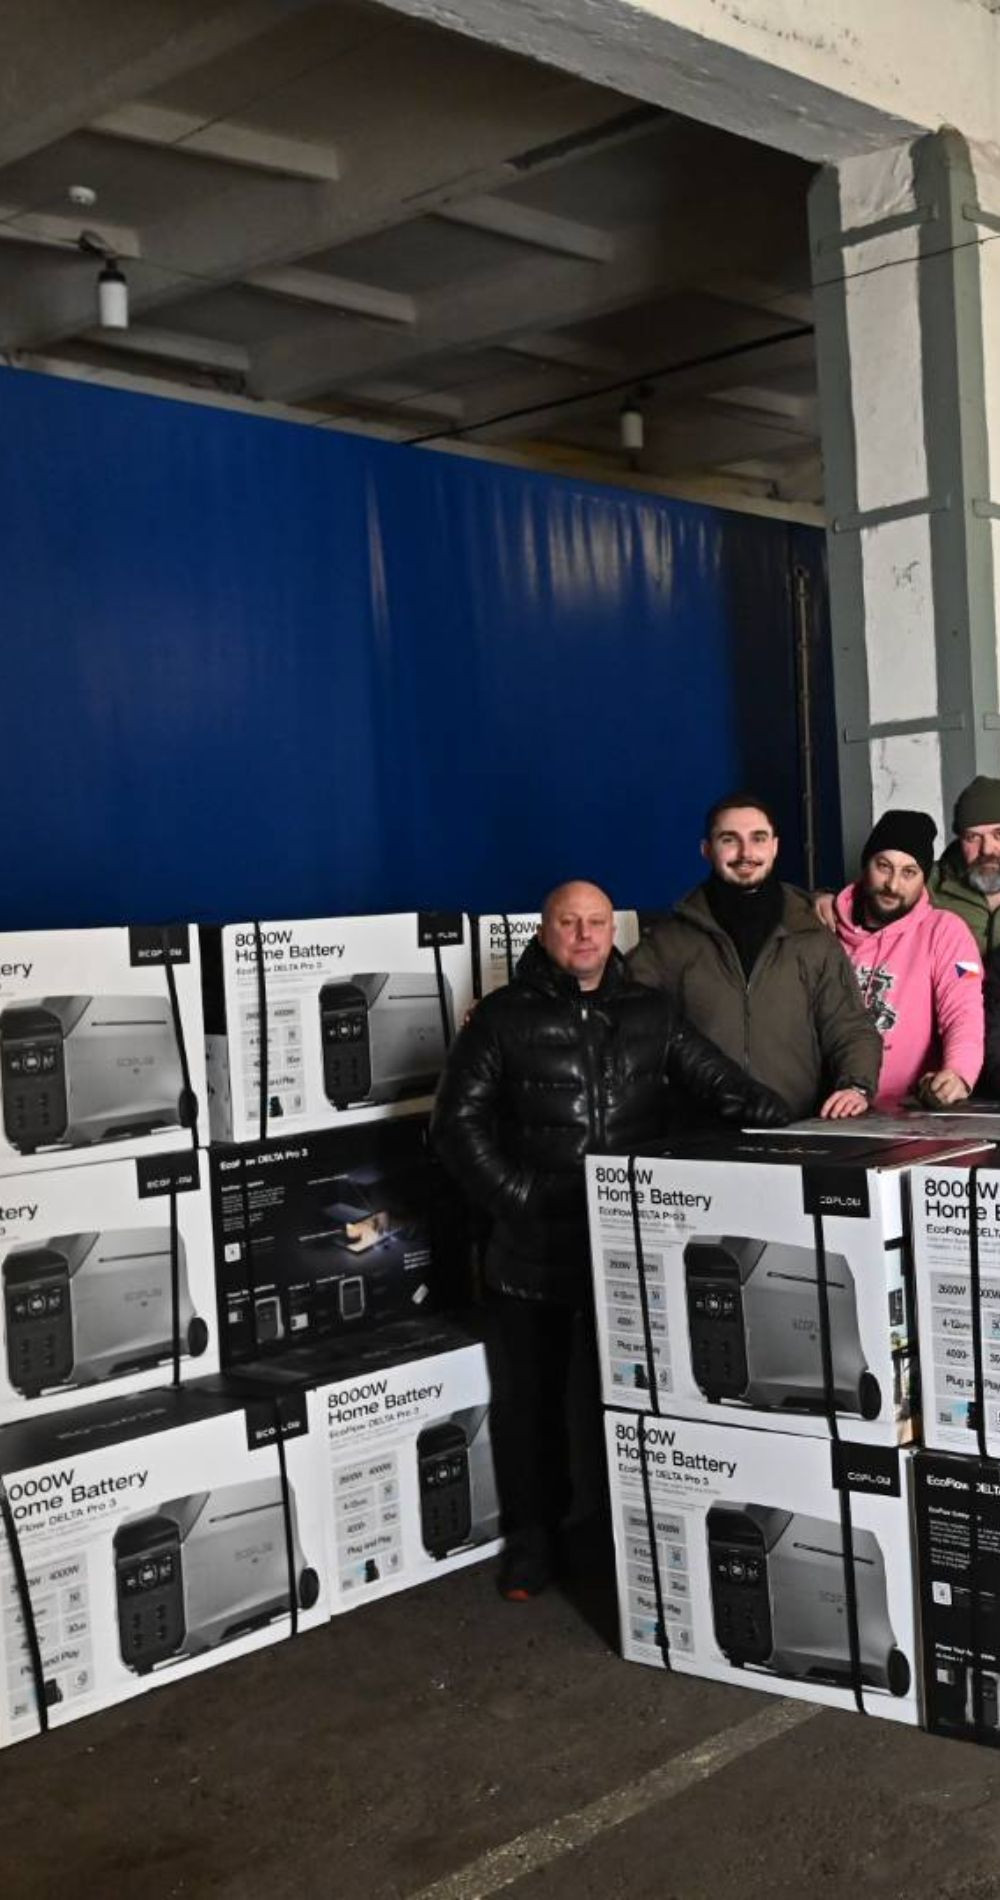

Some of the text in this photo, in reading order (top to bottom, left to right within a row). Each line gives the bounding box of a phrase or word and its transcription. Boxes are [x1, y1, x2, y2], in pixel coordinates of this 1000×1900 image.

[235, 943, 345, 963] Home Battery
[236, 967, 271, 976] EcoFw
[257, 1153, 284, 1164] DELTA
[285, 1150, 300, 1161] Pro
[301, 1147, 309, 1158] 3
[595, 1167, 653, 1185] 800W
[650, 1188, 712, 1212] Battery
[926, 1199, 988, 1220] Home
[926, 1223, 970, 1236] EcoFlow
[327, 1379, 388, 1409] 8000W
[328, 1382, 444, 1426] Home Battery
[329, 1423, 366, 1440] EcoFlow
[368, 1414, 395, 1428] DELTA
[672, 1450, 737, 1479] Battery
[8, 1469, 75, 1502] 000W
[847, 1471, 891, 1487] COFLOW
[926, 1473, 970, 1491] EcoFlow
[13, 1470, 149, 1521] ome Battery
[49, 1508, 84, 1525] DELTA
[86, 1502, 108, 1517] Pro
[109, 1498, 118, 1509] 3
